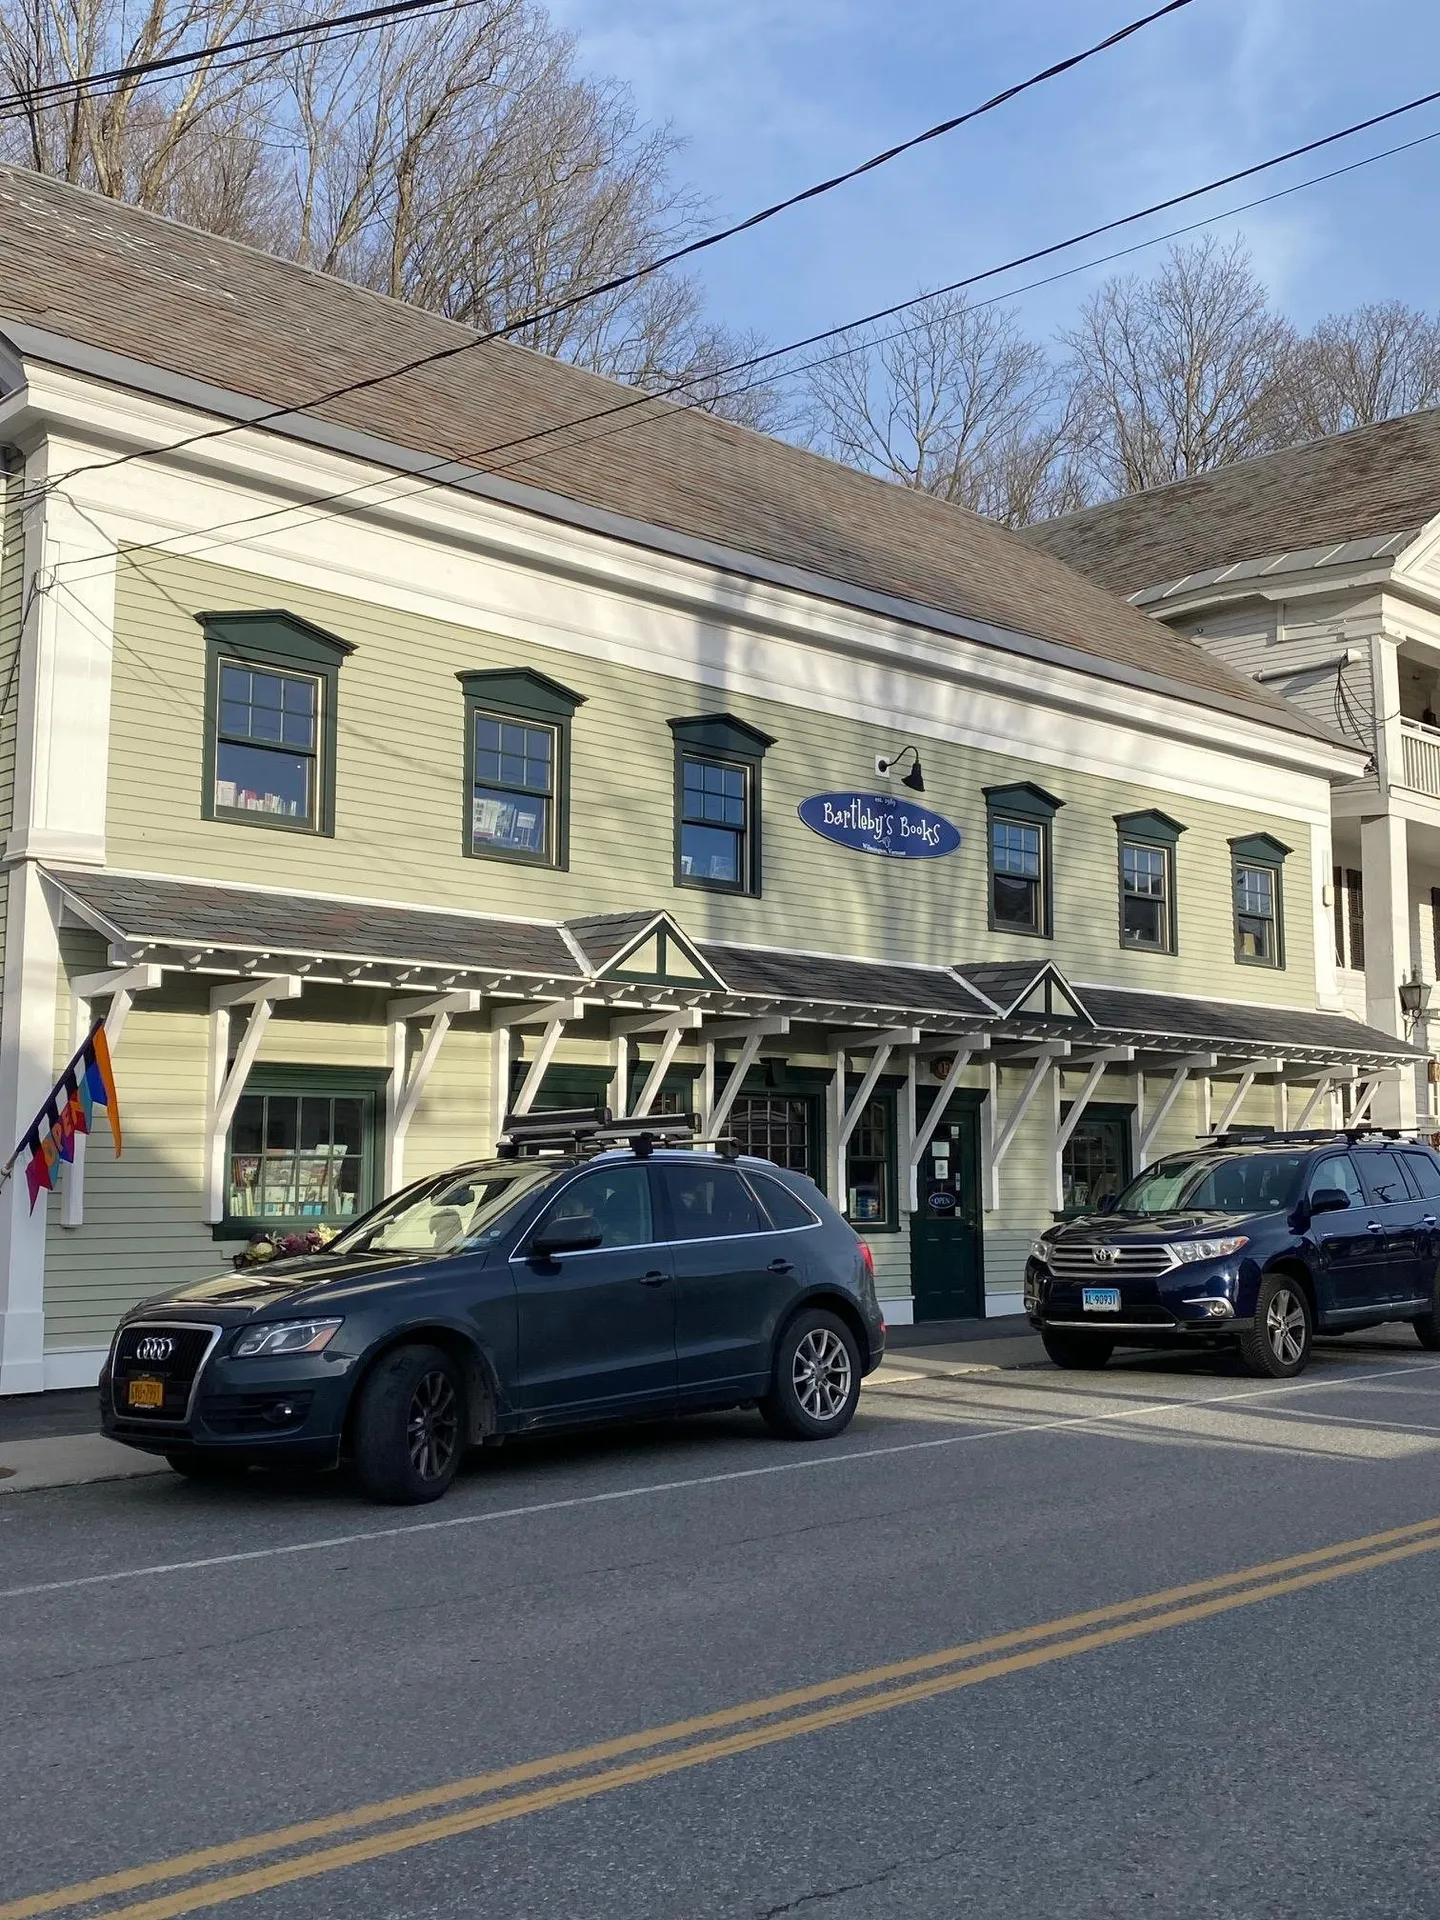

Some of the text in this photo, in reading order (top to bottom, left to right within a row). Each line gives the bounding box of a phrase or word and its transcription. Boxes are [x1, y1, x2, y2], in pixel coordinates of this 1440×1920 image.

[823, 797, 941, 846] Bartleby's Books
[934, 1196, 951, 1205] OPEN
